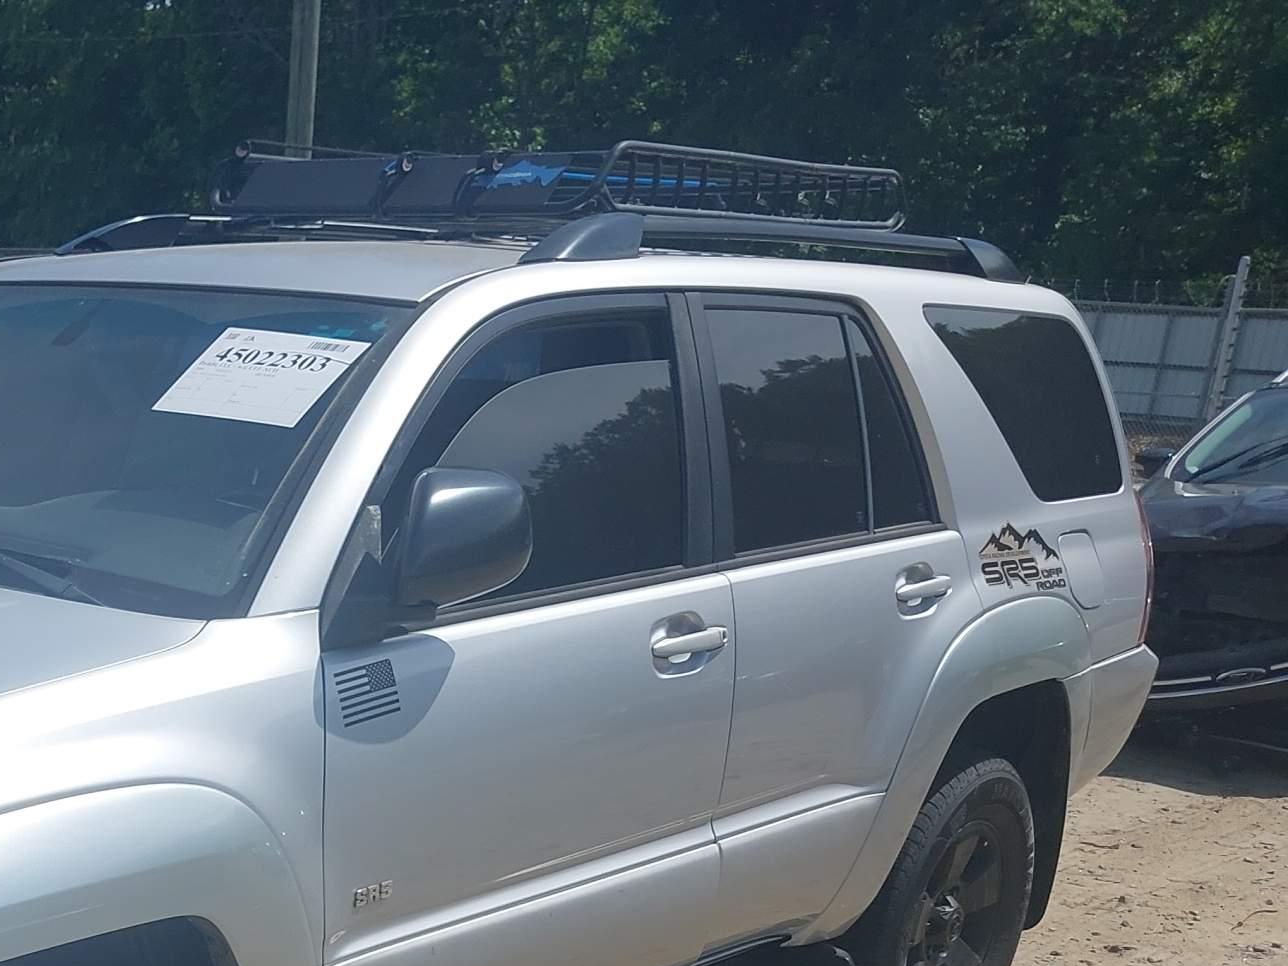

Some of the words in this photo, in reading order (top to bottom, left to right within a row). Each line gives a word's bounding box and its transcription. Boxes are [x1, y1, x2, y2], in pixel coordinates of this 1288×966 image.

[215, 347, 331, 372] 45022303
[1040, 567, 1063, 579] OFF
[1035, 578, 1067, 592] ROAD
[353, 880, 393, 907] SR5
